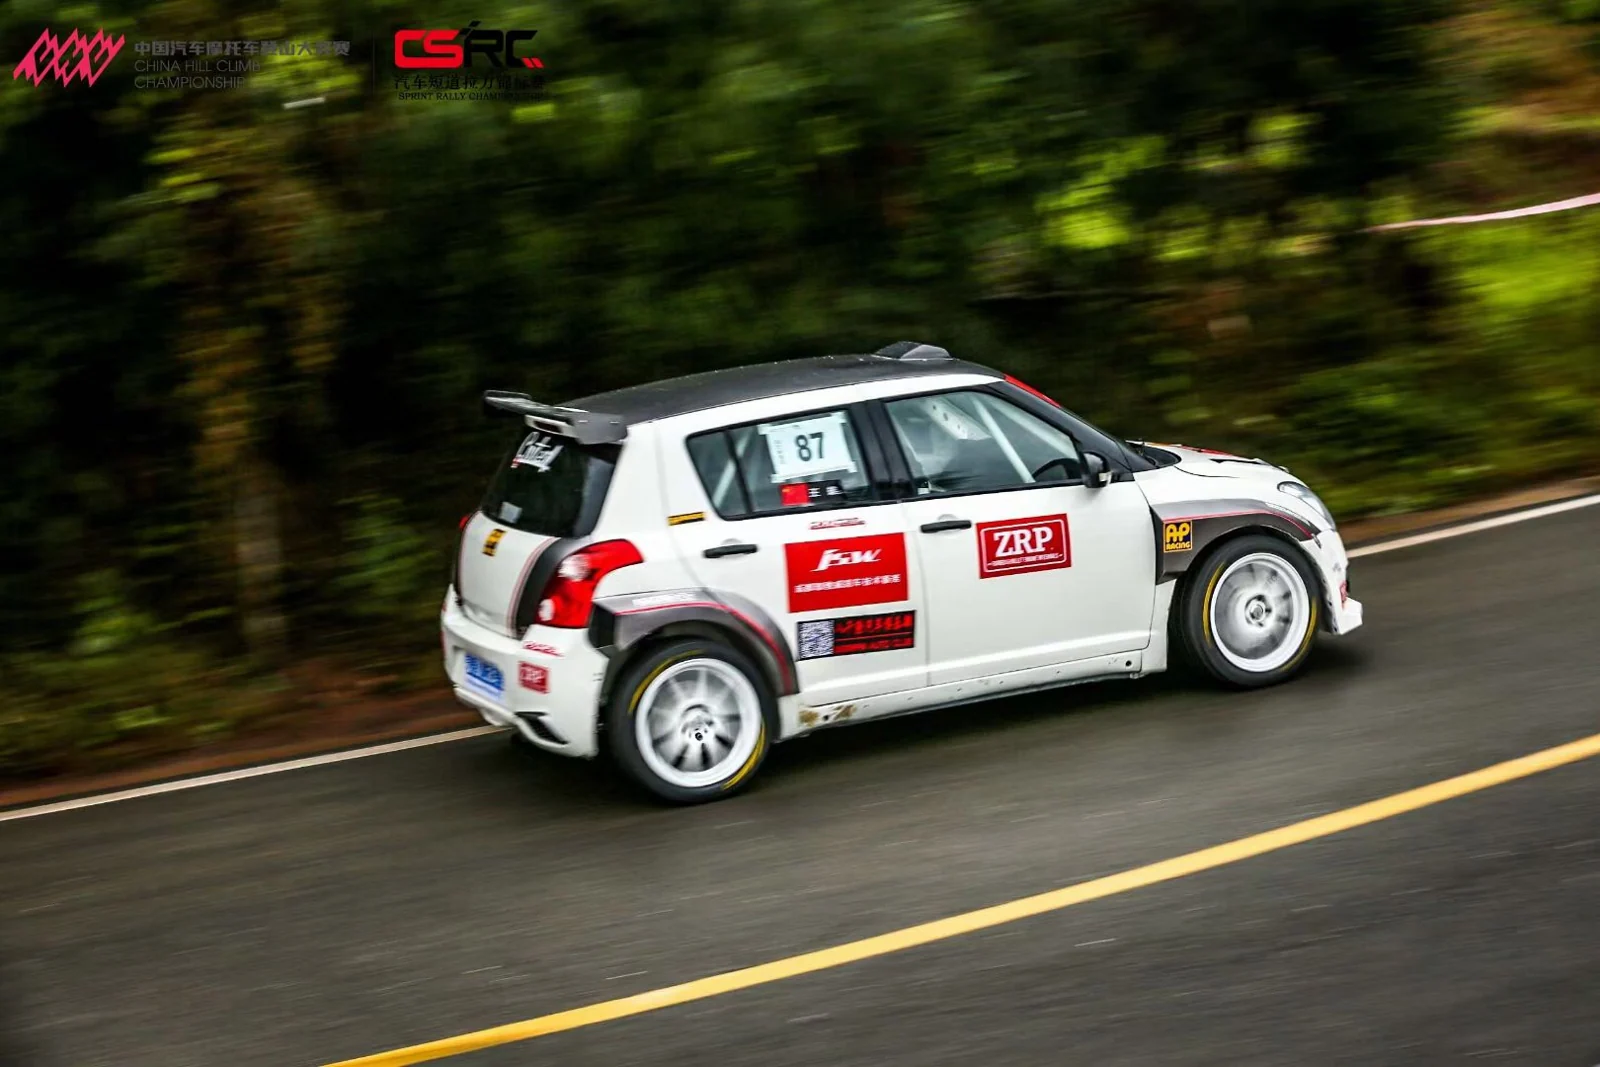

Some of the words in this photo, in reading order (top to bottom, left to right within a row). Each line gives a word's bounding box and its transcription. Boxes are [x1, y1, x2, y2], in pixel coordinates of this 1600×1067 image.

[795, 431, 824, 462] 87
[993, 526, 1054, 558] ZRP
[1166, 522, 1190, 543] AP
